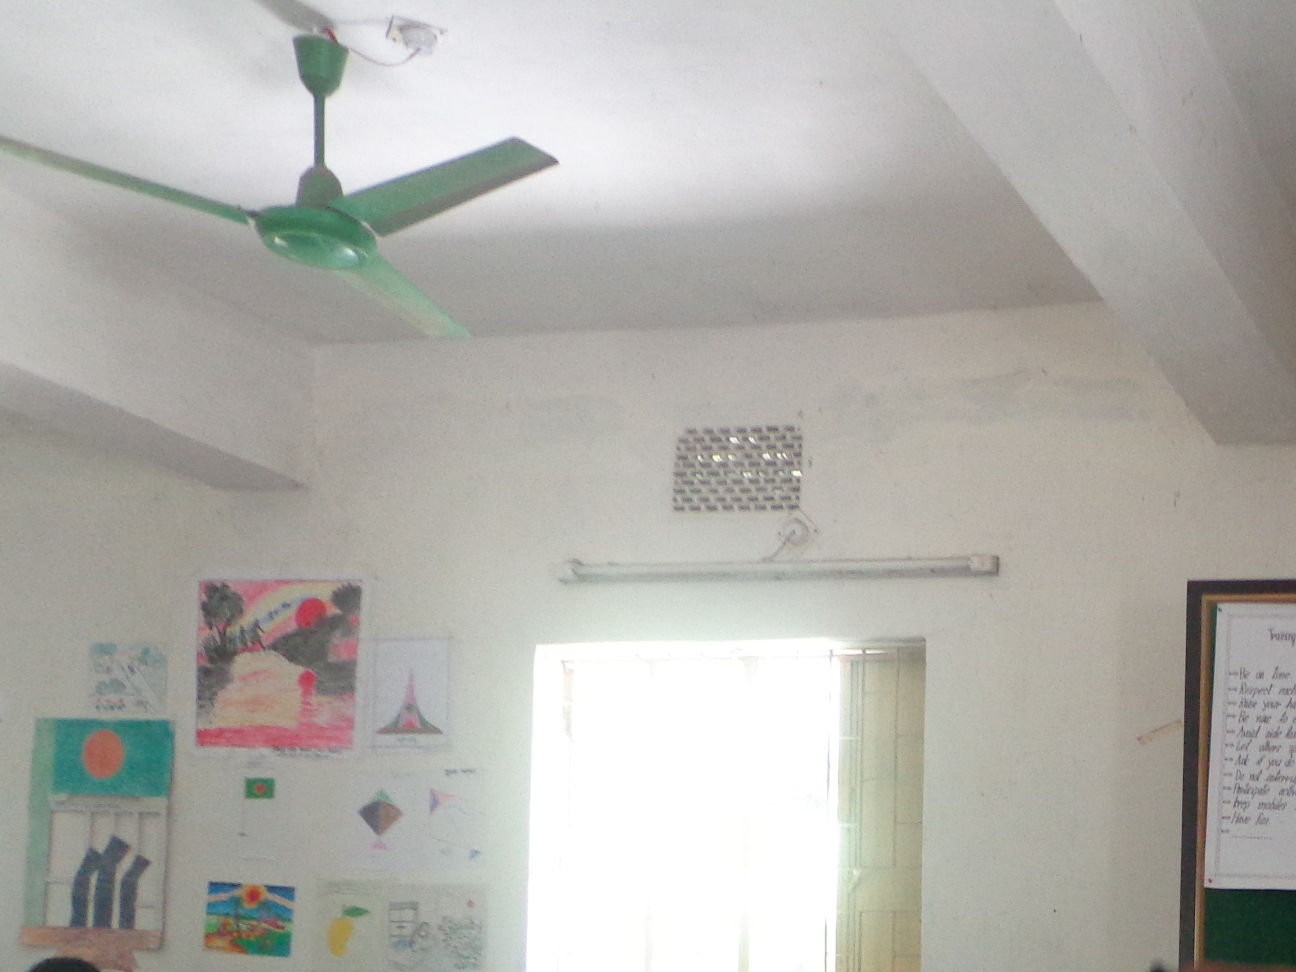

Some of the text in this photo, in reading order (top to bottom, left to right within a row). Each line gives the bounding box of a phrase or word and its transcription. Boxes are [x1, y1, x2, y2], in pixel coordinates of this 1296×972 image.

[1239, 667, 1250, 680] Be
[1255, 670, 1265, 680] on
[1239, 683, 1274, 698] Respect
[1262, 701, 1282, 713] your
[1238, 712, 1250, 724] Be
[1279, 711, 1289, 724] to
[1236, 725, 1261, 739] Avoid
[1265, 725, 1282, 739] side
[1235, 739, 1252, 752] Let
[1258, 740, 1282, 753] others
[1235, 753, 1250, 767] Ask
[1266, 757, 1282, 771] you
[1284, 753, 1295, 767] do
[1235, 769, 1245, 781] Do
[1249, 769, 1263, 781] not
[1231, 810, 1251, 825] Have
